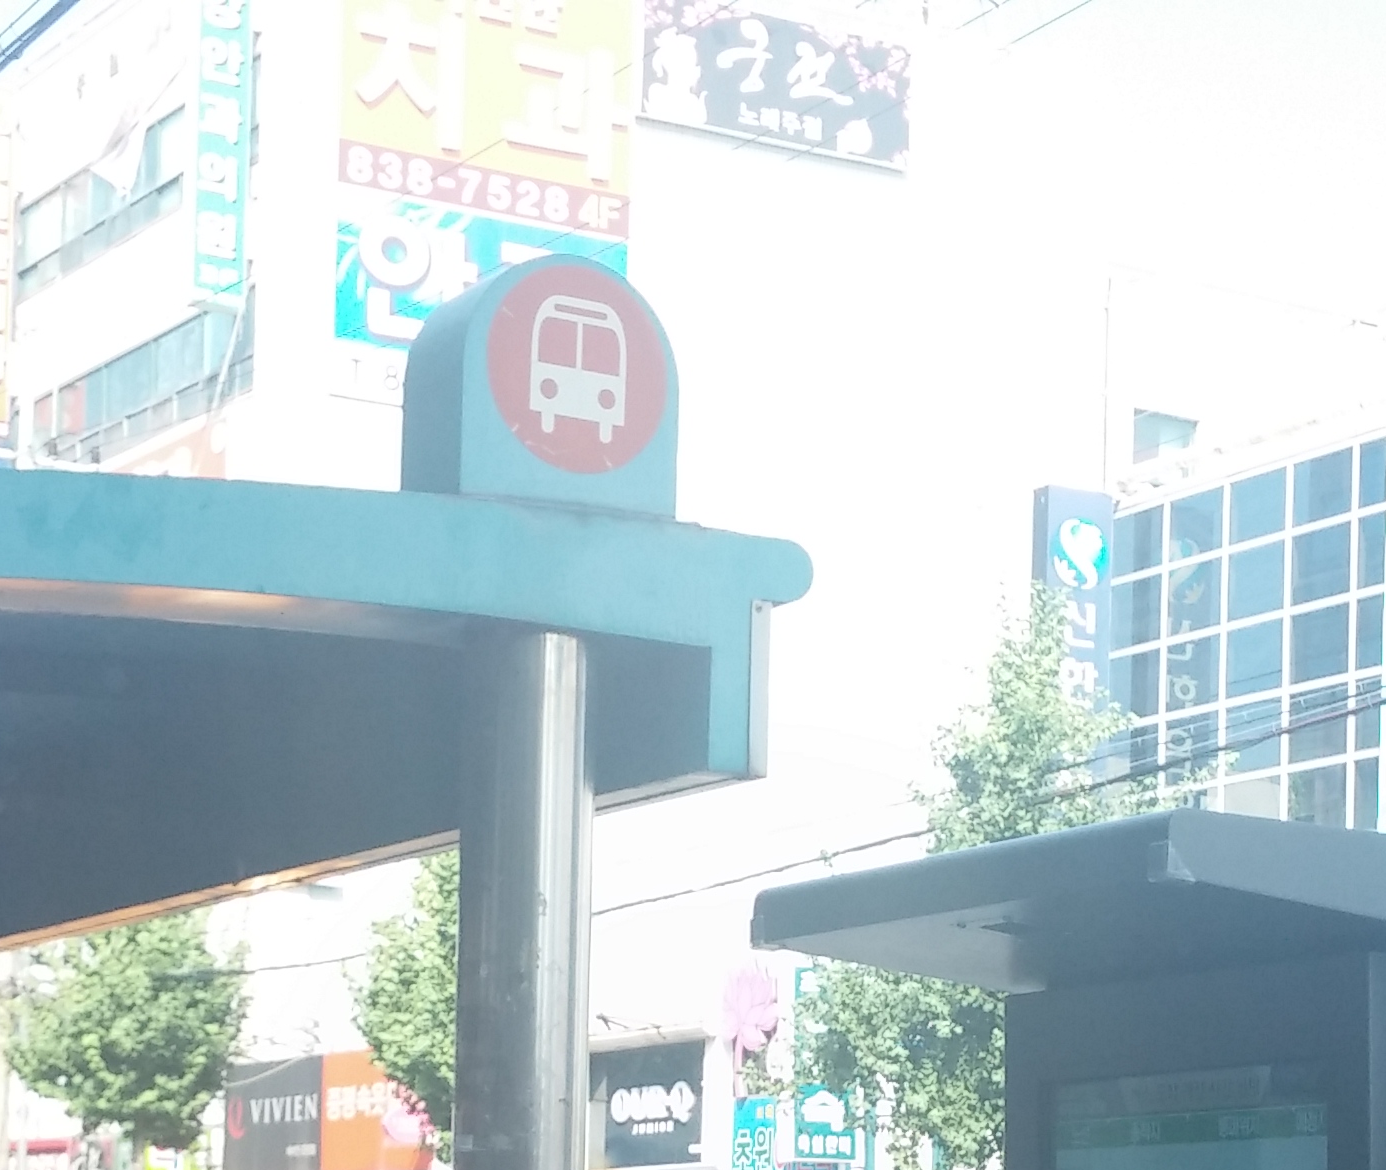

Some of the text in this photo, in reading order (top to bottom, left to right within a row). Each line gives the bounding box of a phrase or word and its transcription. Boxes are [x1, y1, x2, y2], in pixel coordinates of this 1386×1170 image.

[355, 8, 627, 184] 치과
[346, 146, 622, 229] 838-7528 4F
[249, 1094, 318, 1123] VIVIEN
